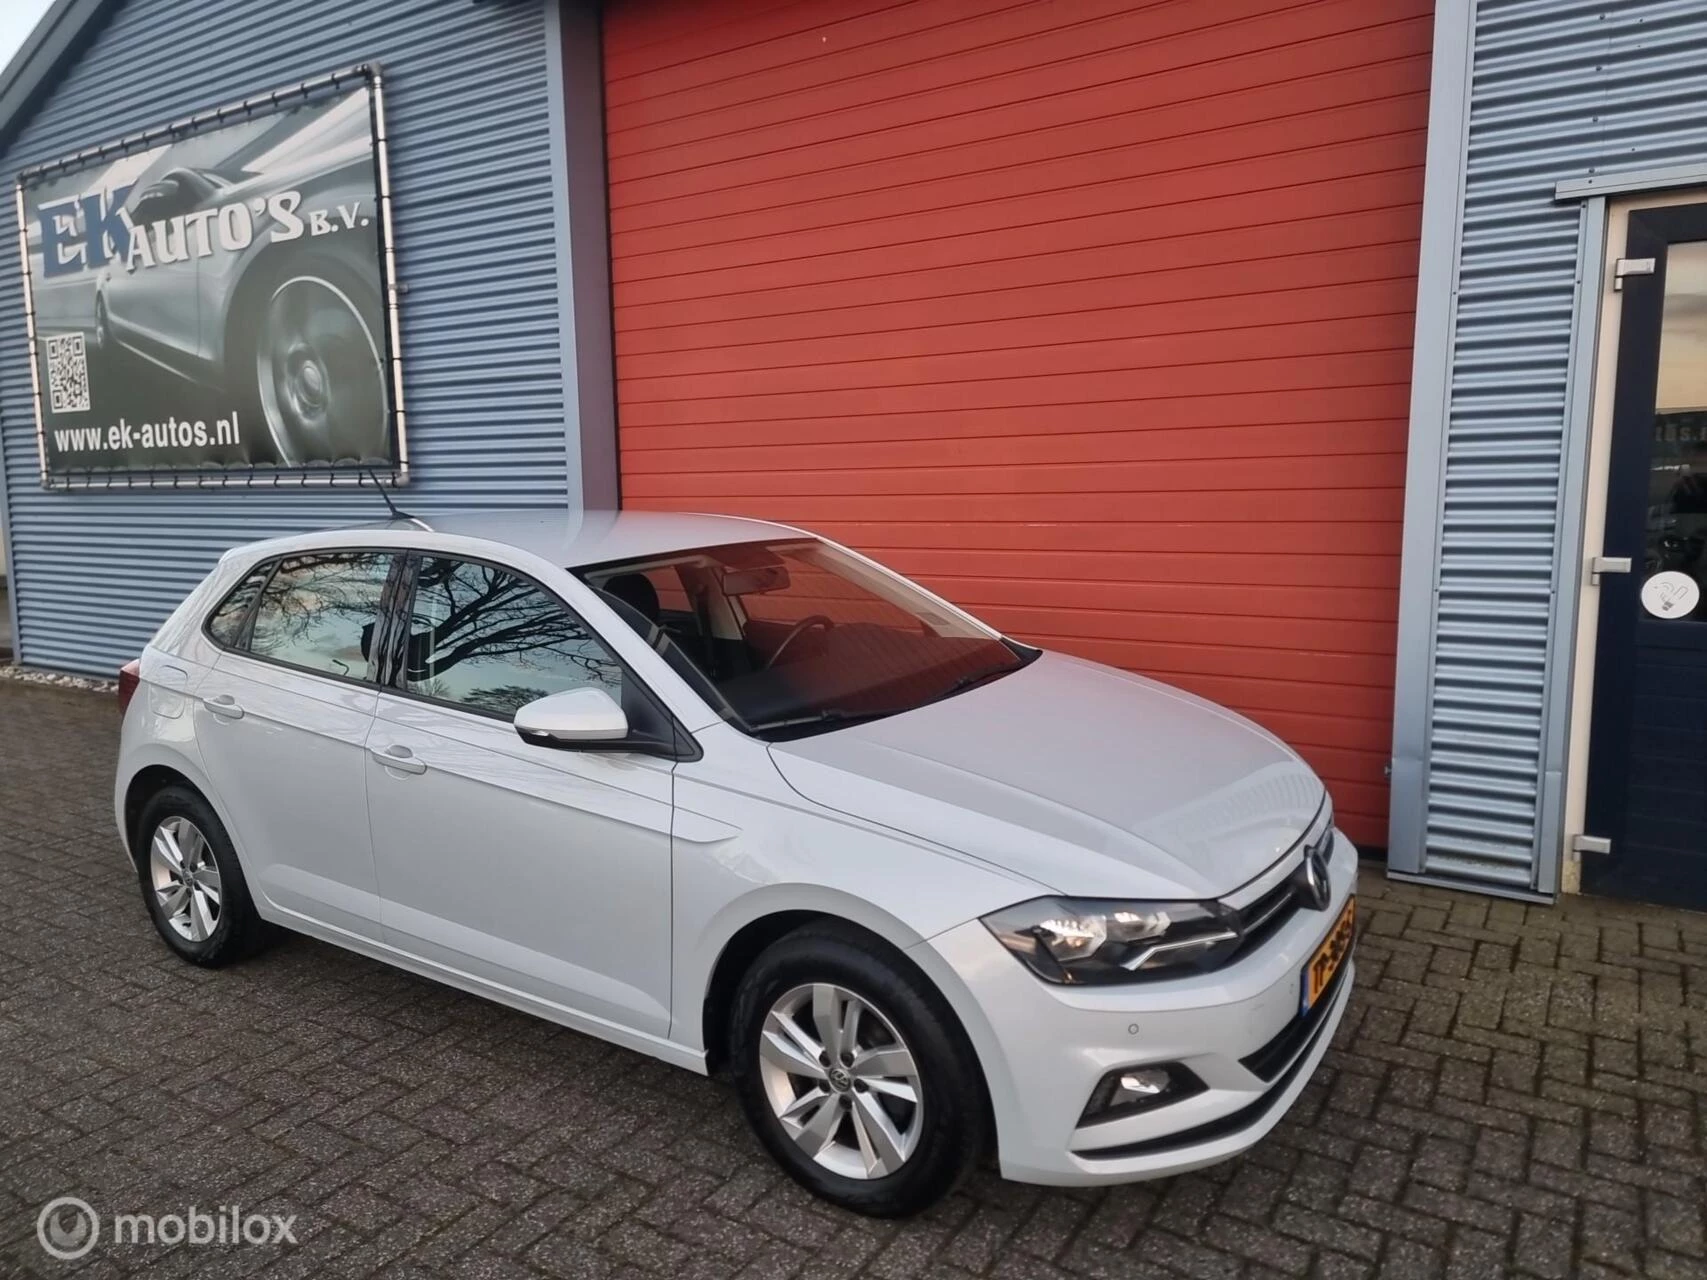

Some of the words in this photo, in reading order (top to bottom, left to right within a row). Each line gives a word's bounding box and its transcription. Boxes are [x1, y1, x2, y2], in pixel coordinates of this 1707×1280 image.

[38, 180, 138, 278] EK
[309, 202, 370, 237] B.V.
[54, 411, 240, 453] www.ek-autos.nl
